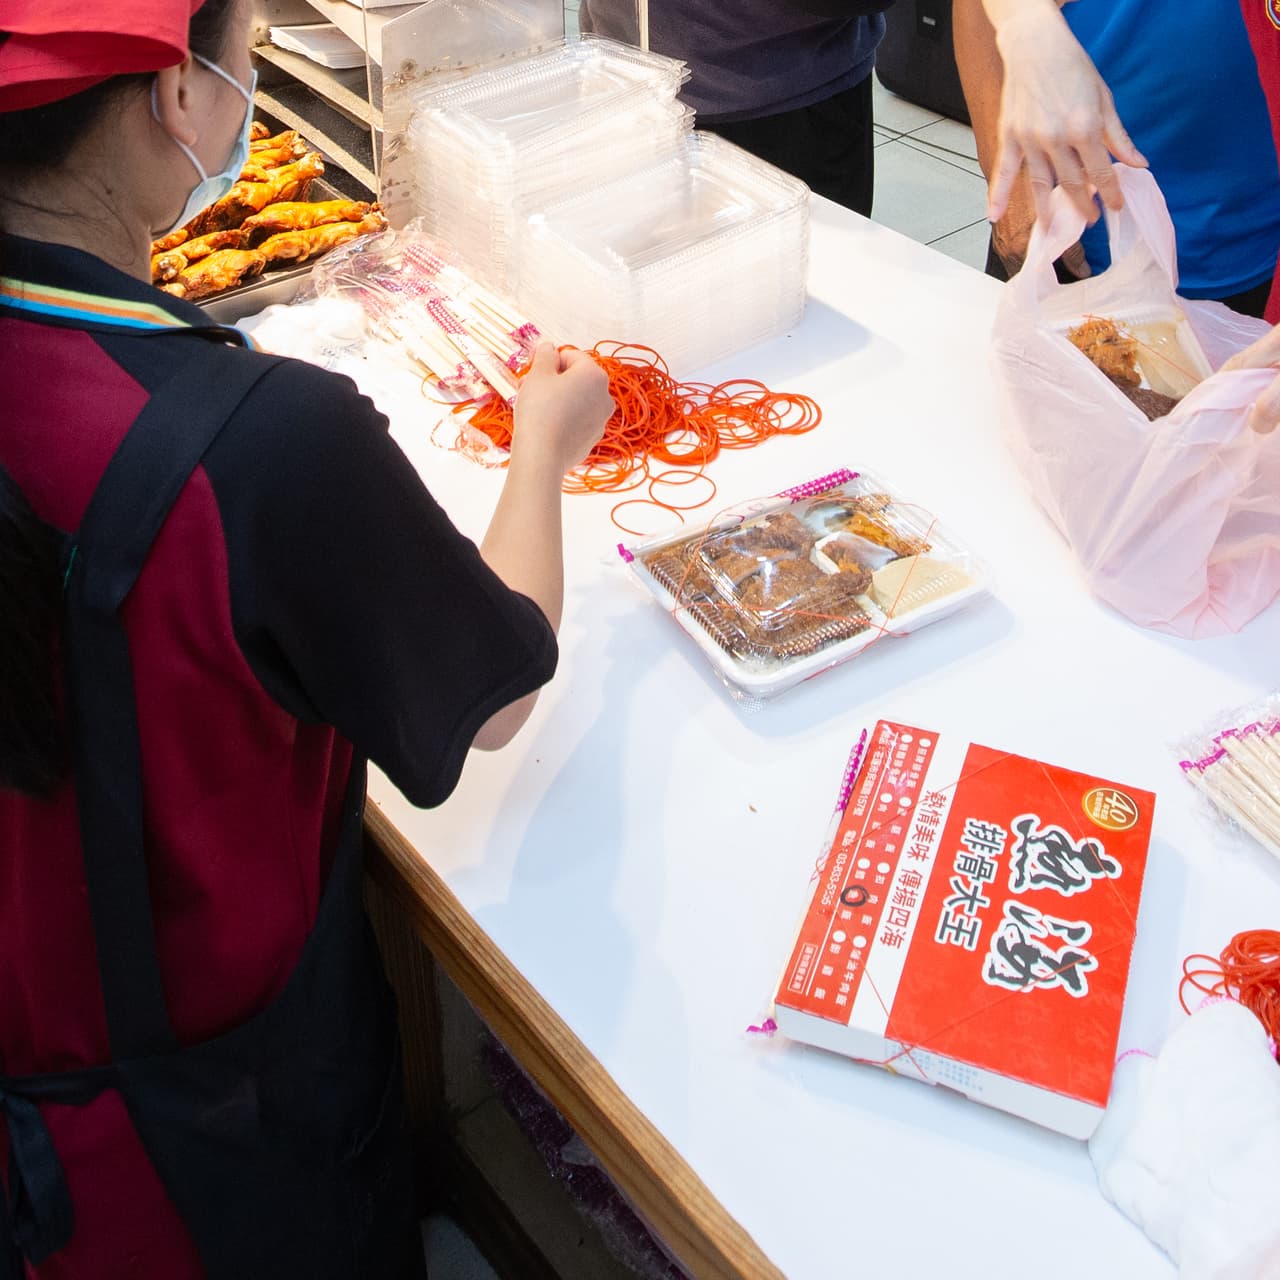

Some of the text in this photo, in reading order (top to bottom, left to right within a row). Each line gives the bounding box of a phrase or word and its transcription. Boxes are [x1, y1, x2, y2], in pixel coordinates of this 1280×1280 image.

[880, 790, 947, 950] 熱情美味 傳揚四海
[935, 818, 1007, 950] 排骨大王
